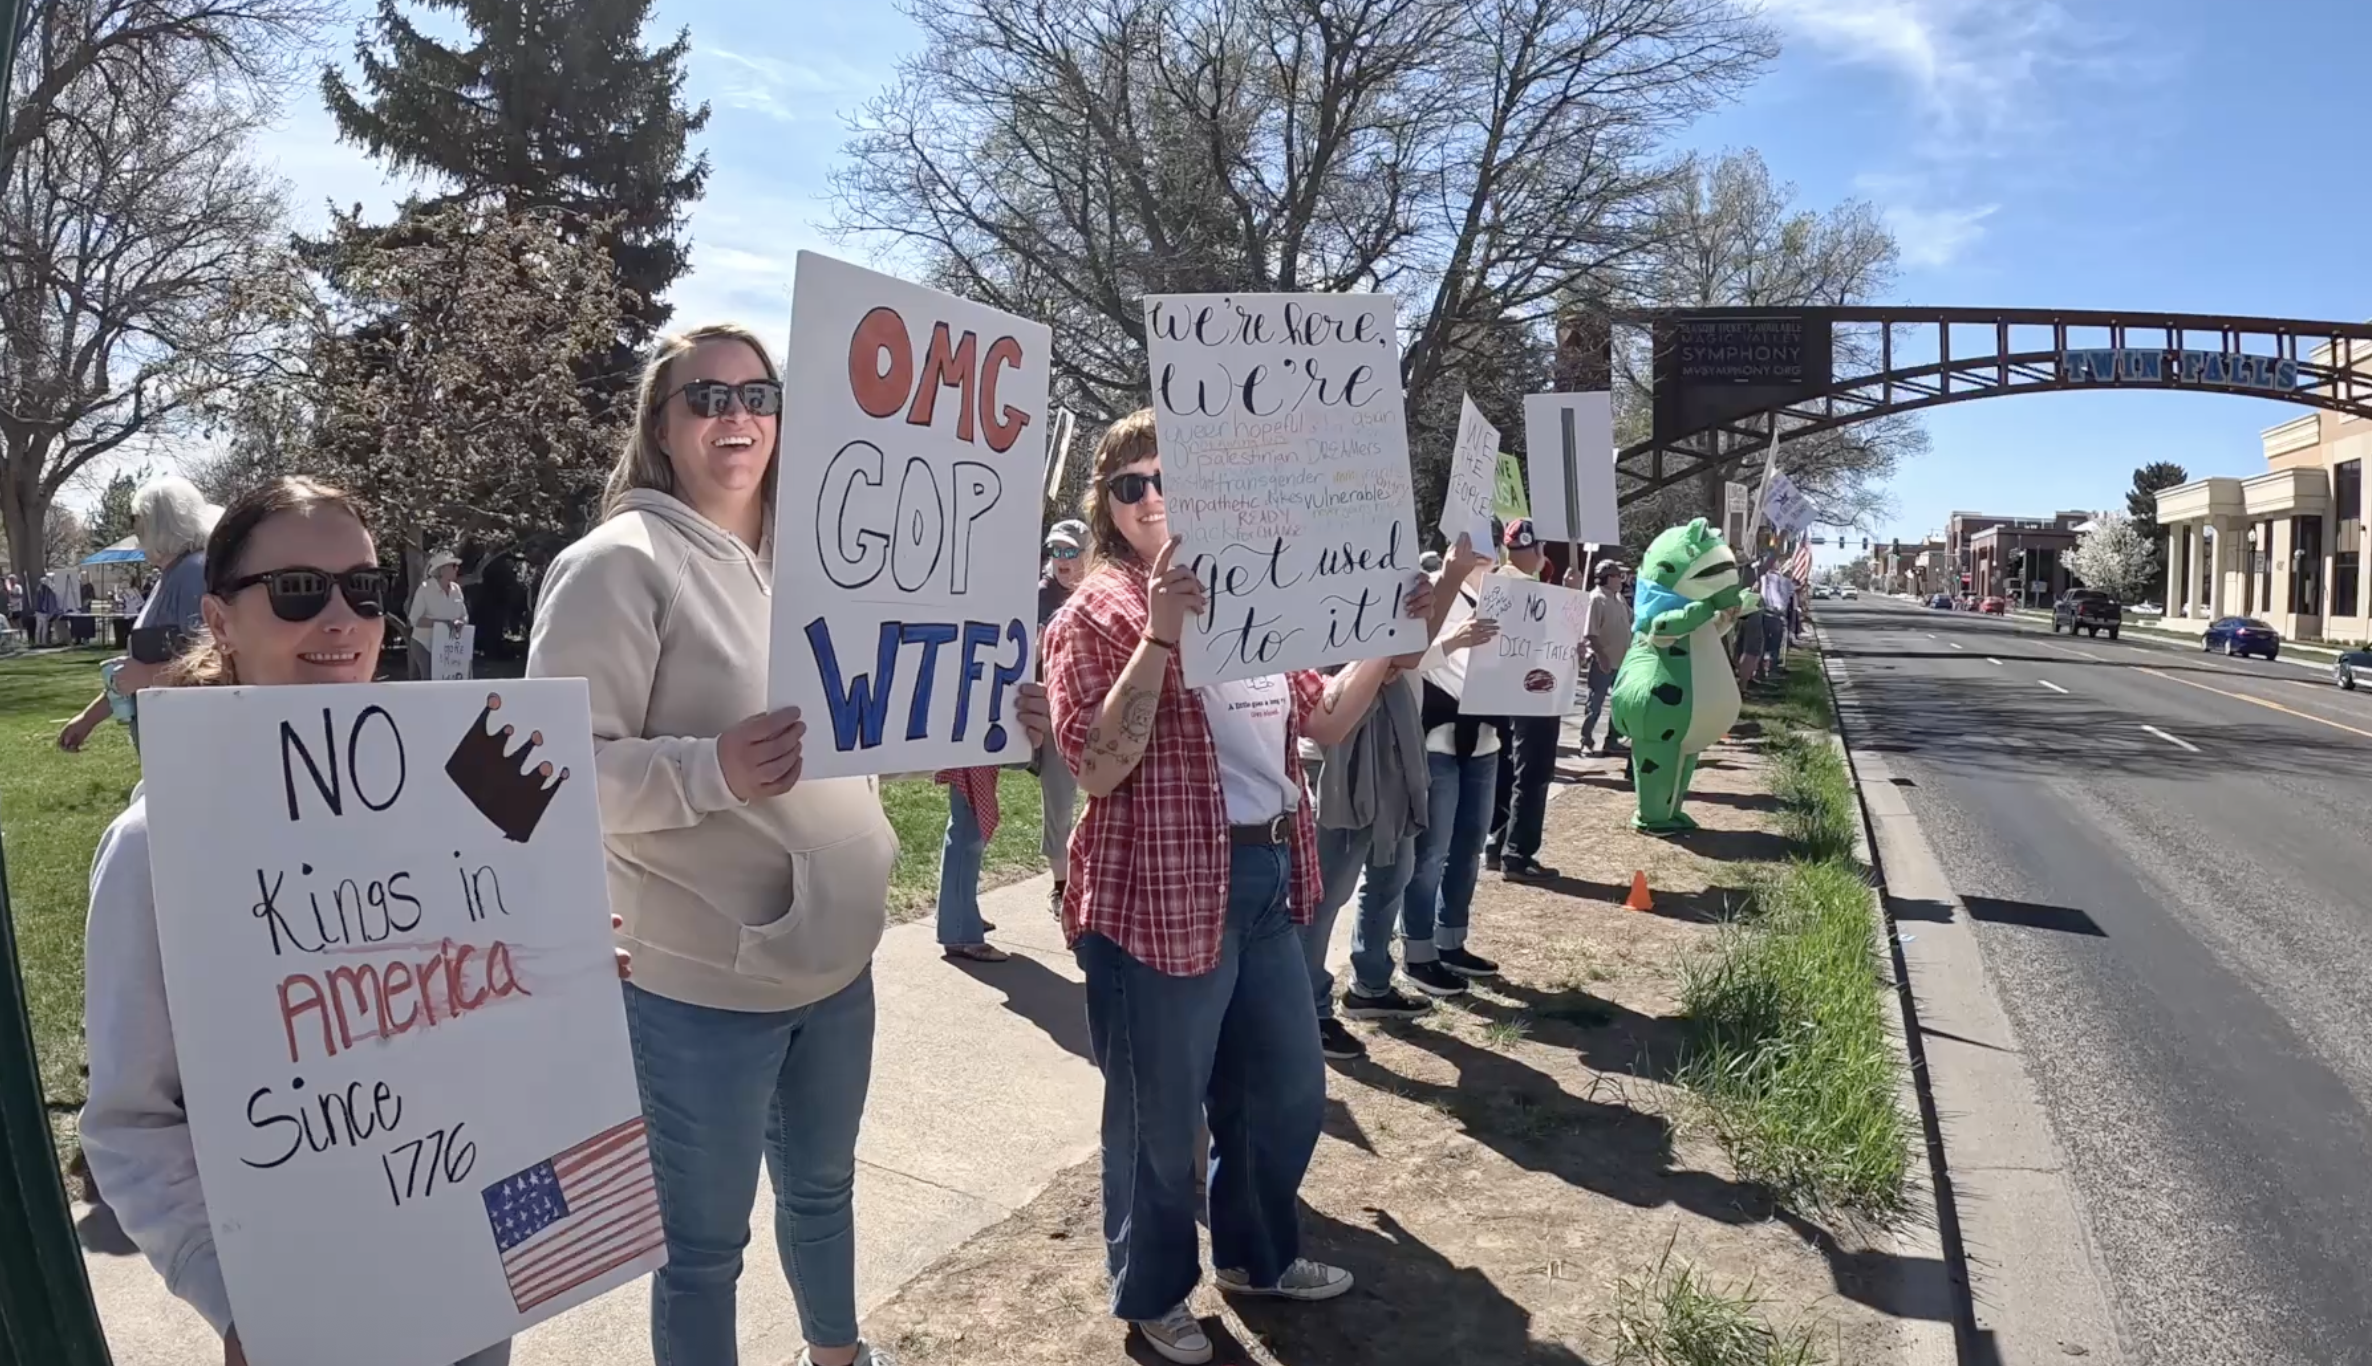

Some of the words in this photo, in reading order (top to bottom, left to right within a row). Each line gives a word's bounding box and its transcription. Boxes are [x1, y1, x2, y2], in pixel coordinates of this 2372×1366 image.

[1279, 302, 1387, 348] here,
[1681, 333, 1733, 344] MAGIC
[1743, 333, 1801, 344] VALLEY
[1682, 346, 1801, 361] SYMPHONY
[1682, 365, 1802, 376] MVSYMPHONYORG
[2062, 349, 2164, 383] TWIN
[2181, 351, 2298, 392] FALLS
[849, 306, 1031, 453] OMG
[1165, 421, 1228, 470] queer
[1234, 408, 1303, 444] hopeful
[1467, 417, 1494, 463] WE
[1197, 448, 1299, 480] palestinian
[1215, 467, 1324, 494] transgender
[1460, 446, 1484, 479] THE
[816, 440, 1002, 595] GOP
[1169, 494, 1259, 521] empathetic
[1239, 508, 1289, 526] READY
[1305, 484, 1391, 509] vulnerable
[1171, 515, 1239, 544] black
[1190, 537, 1303, 635] get
[1309, 521, 1411, 582] used
[1206, 607, 1305, 675] to
[1320, 582, 1404, 653] it!
[1523, 591, 1548, 624] NO
[804, 617, 1029, 753] WTF?
[279, 704, 407, 822] NO
[453, 850, 510, 922] in
[276, 937, 532, 1063] America
[382, 1122, 477, 1206] 1776
